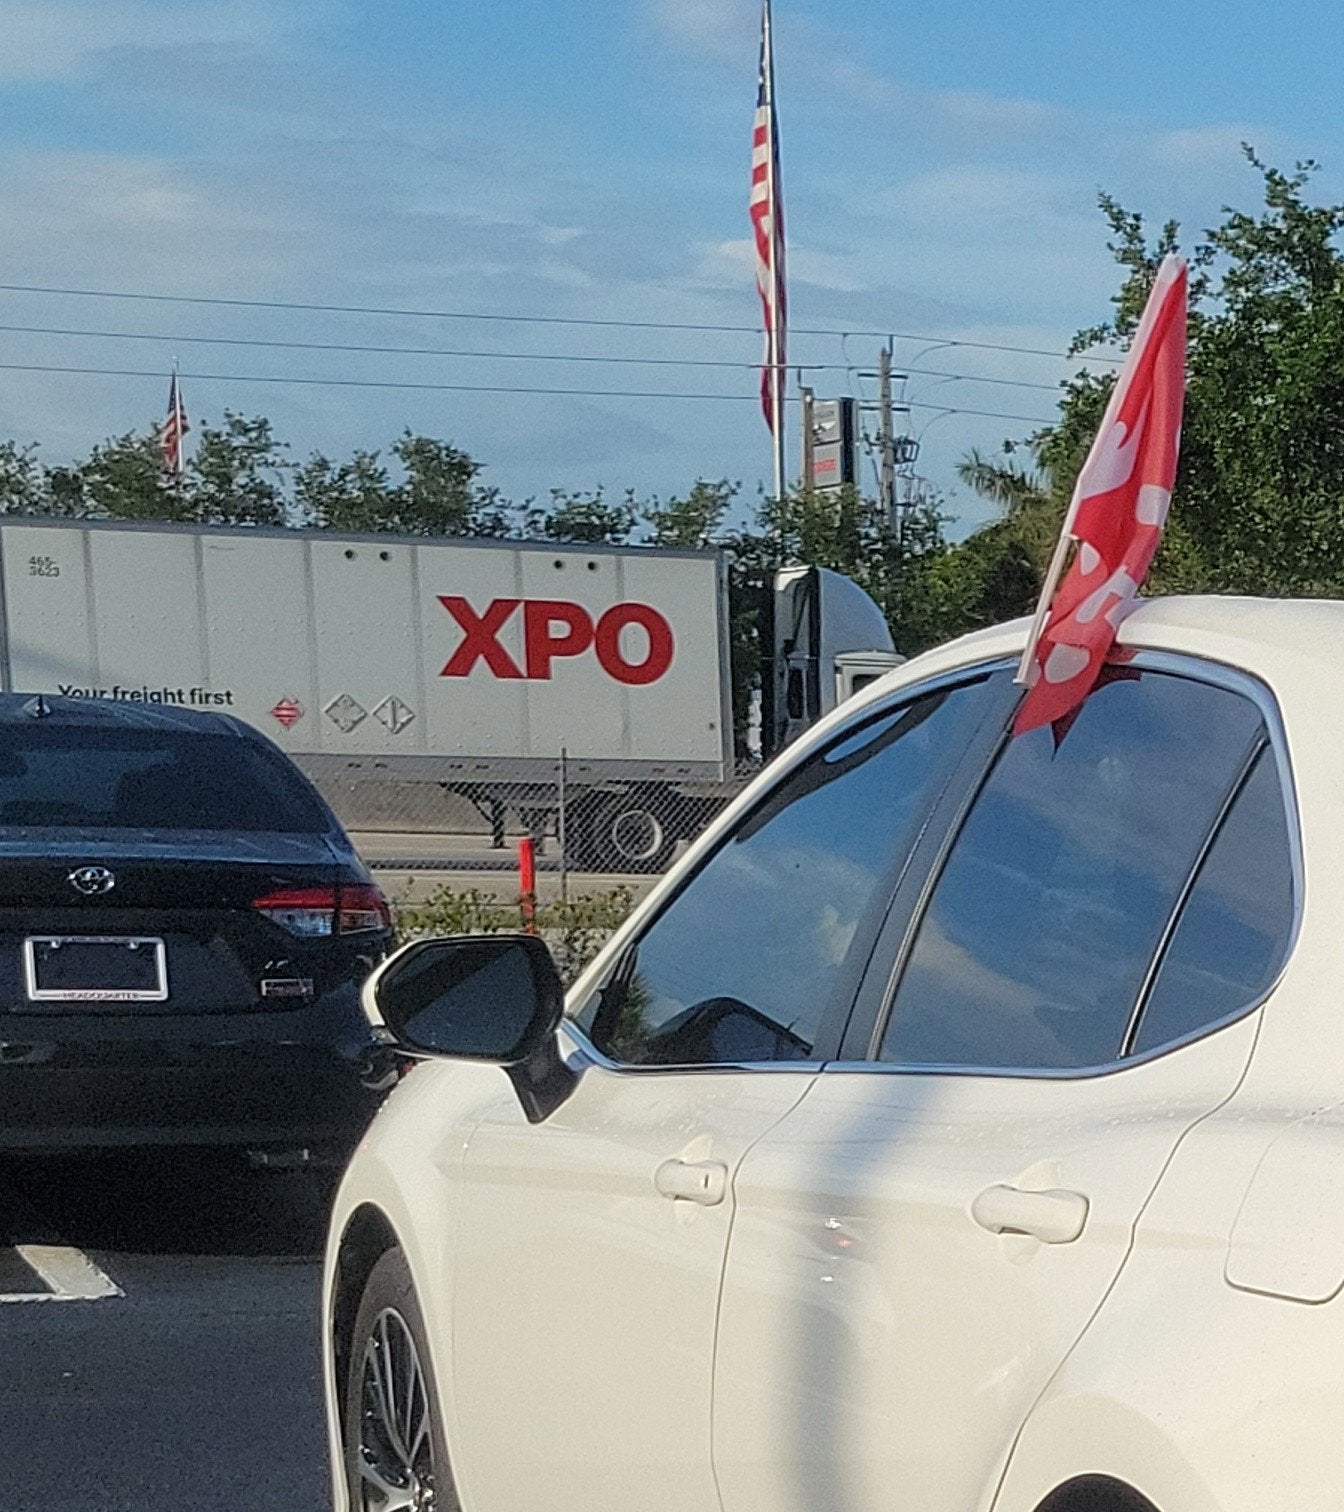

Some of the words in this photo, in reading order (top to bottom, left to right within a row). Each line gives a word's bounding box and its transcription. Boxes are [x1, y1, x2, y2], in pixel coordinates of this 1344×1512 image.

[436, 595, 675, 685] XPO
[112, 685, 185, 705] freight
[189, 687, 233, 706] first
